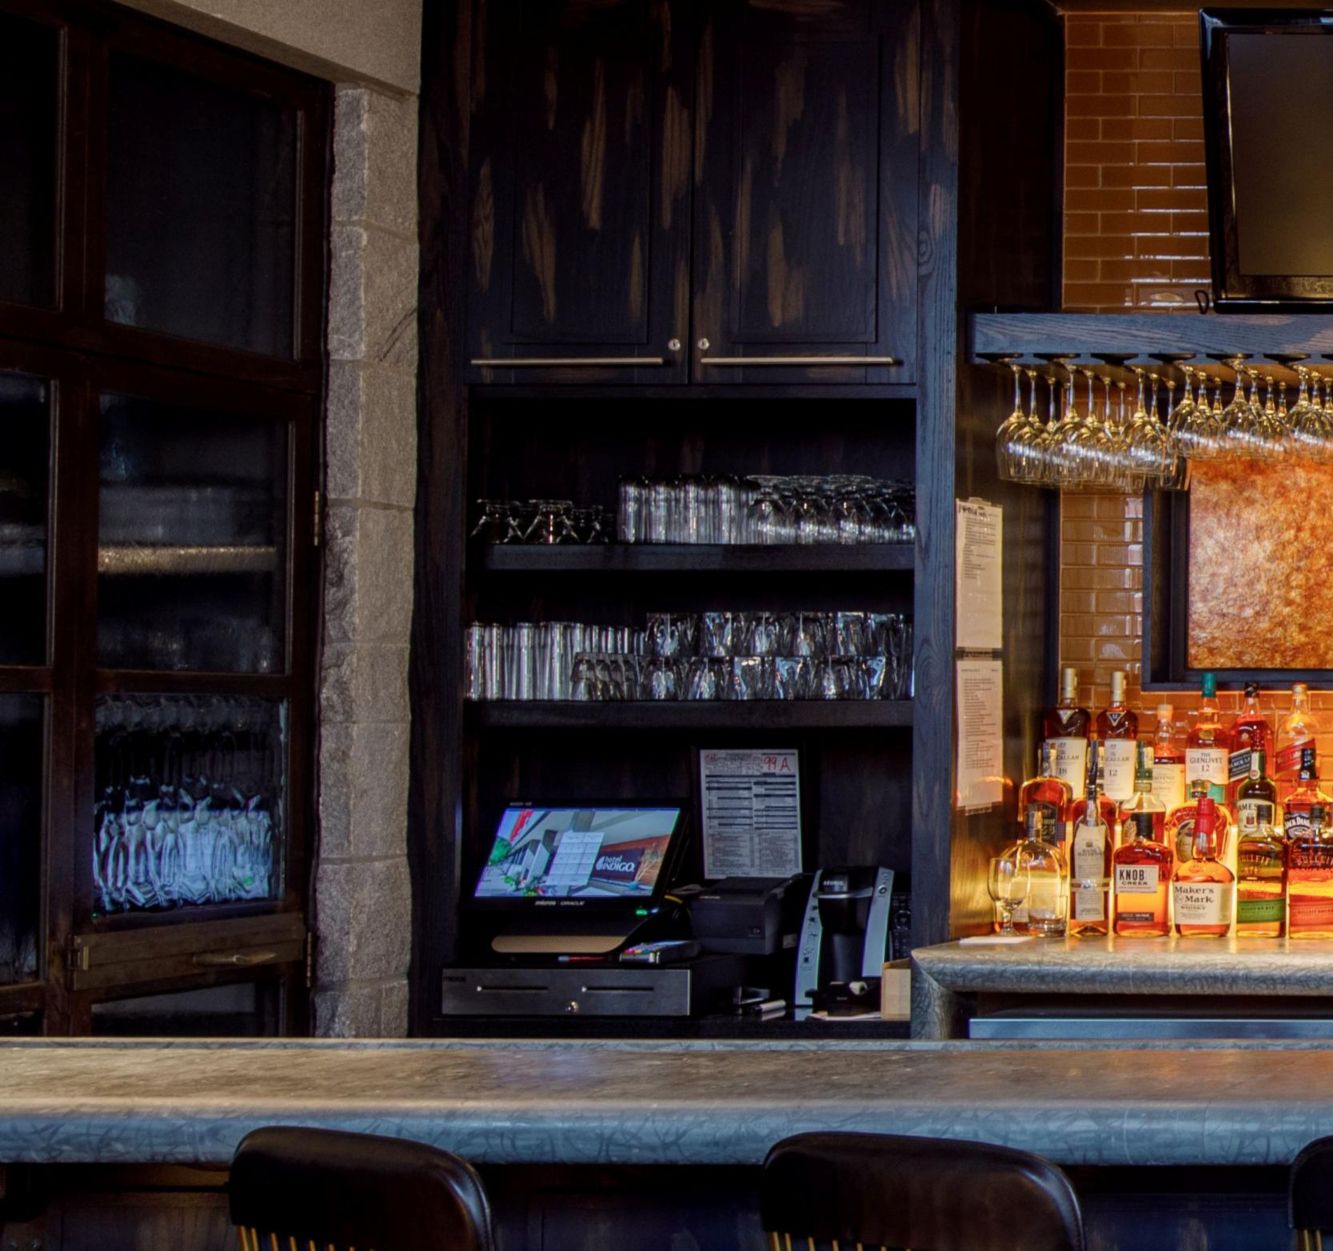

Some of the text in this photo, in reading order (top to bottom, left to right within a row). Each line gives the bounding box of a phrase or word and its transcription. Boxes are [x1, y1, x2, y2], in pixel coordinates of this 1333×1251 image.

[780, 756, 791, 772] A
[1200, 764, 1210, 773] 12
[1109, 769, 1118, 777] 12
[1119, 869, 1145, 881] KNOB
[1174, 885, 1215, 895] Maker's
[1184, 895, 1215, 904] Mark
